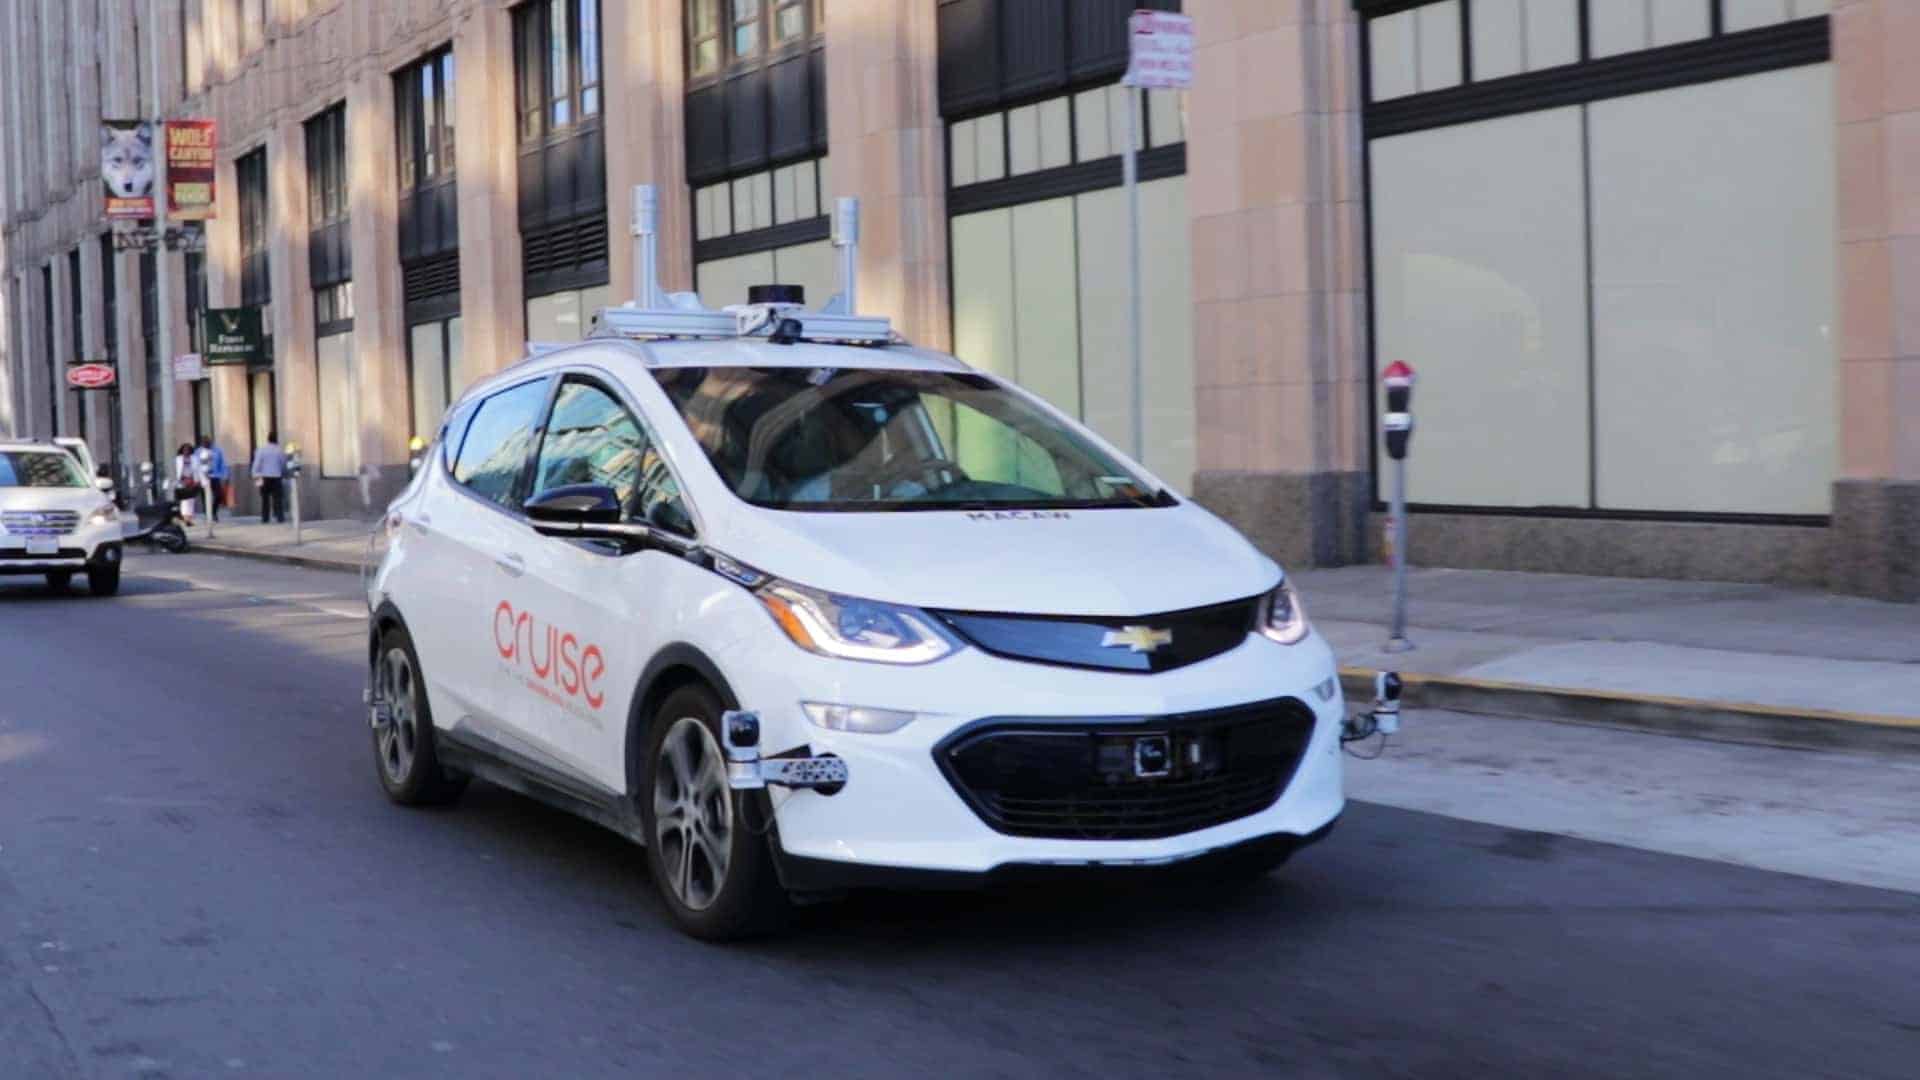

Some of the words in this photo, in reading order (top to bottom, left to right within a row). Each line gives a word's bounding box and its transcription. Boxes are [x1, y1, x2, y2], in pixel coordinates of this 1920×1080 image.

[170, 127, 213, 146] WOLF
[967, 511, 1071, 520] MACAW
[494, 600, 605, 709] cruise
